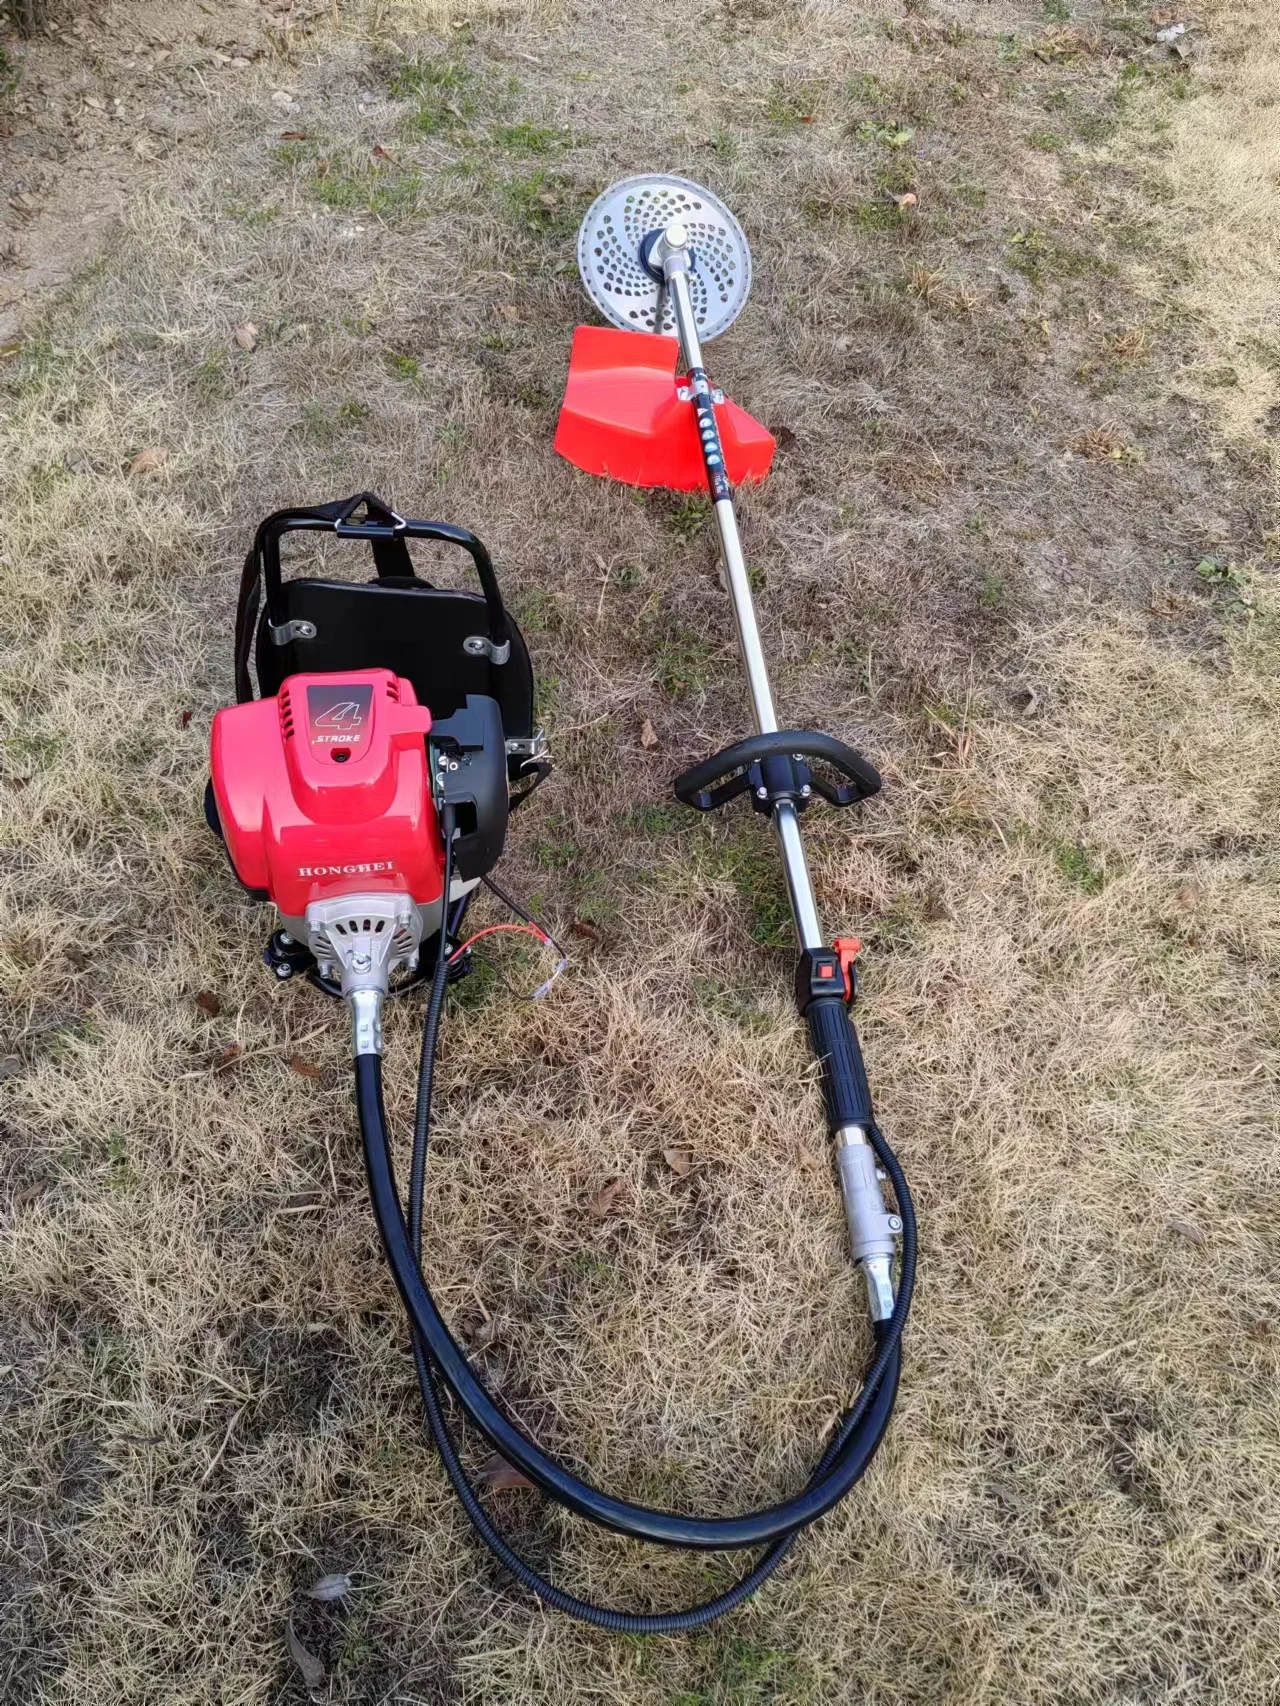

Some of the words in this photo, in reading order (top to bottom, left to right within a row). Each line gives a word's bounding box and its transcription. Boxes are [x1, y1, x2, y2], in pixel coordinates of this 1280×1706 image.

[315, 702, 362, 730] 4
[315, 734, 361, 743] STROKE
[298, 861, 394, 877] HONGHEI
